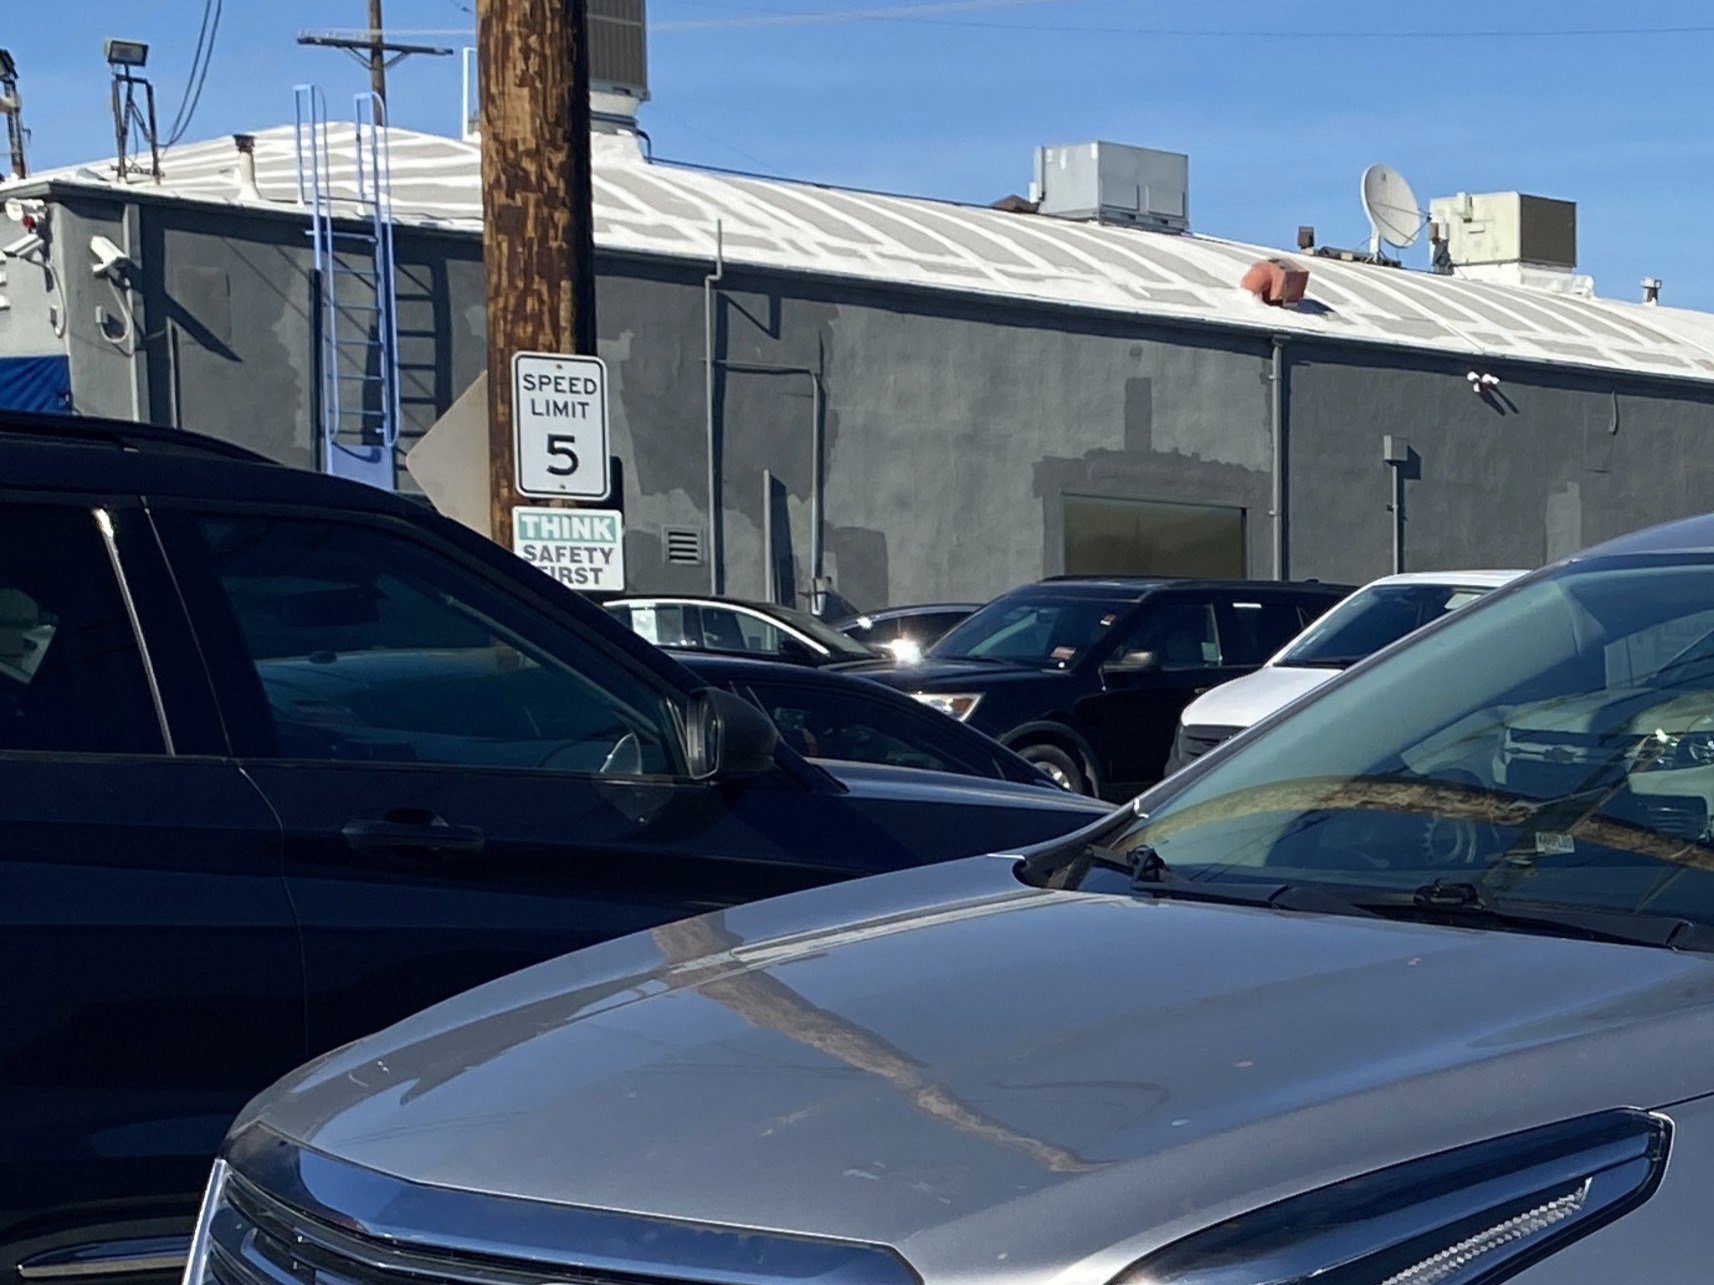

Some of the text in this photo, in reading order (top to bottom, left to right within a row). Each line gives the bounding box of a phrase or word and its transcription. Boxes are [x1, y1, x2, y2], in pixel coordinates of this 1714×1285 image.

[522, 373, 597, 395] SPEED
[531, 399, 590, 419] LIMIT
[547, 433, 579, 476] 5
[520, 515, 614, 540] THINK
[523, 544, 614, 565] SAFETY
